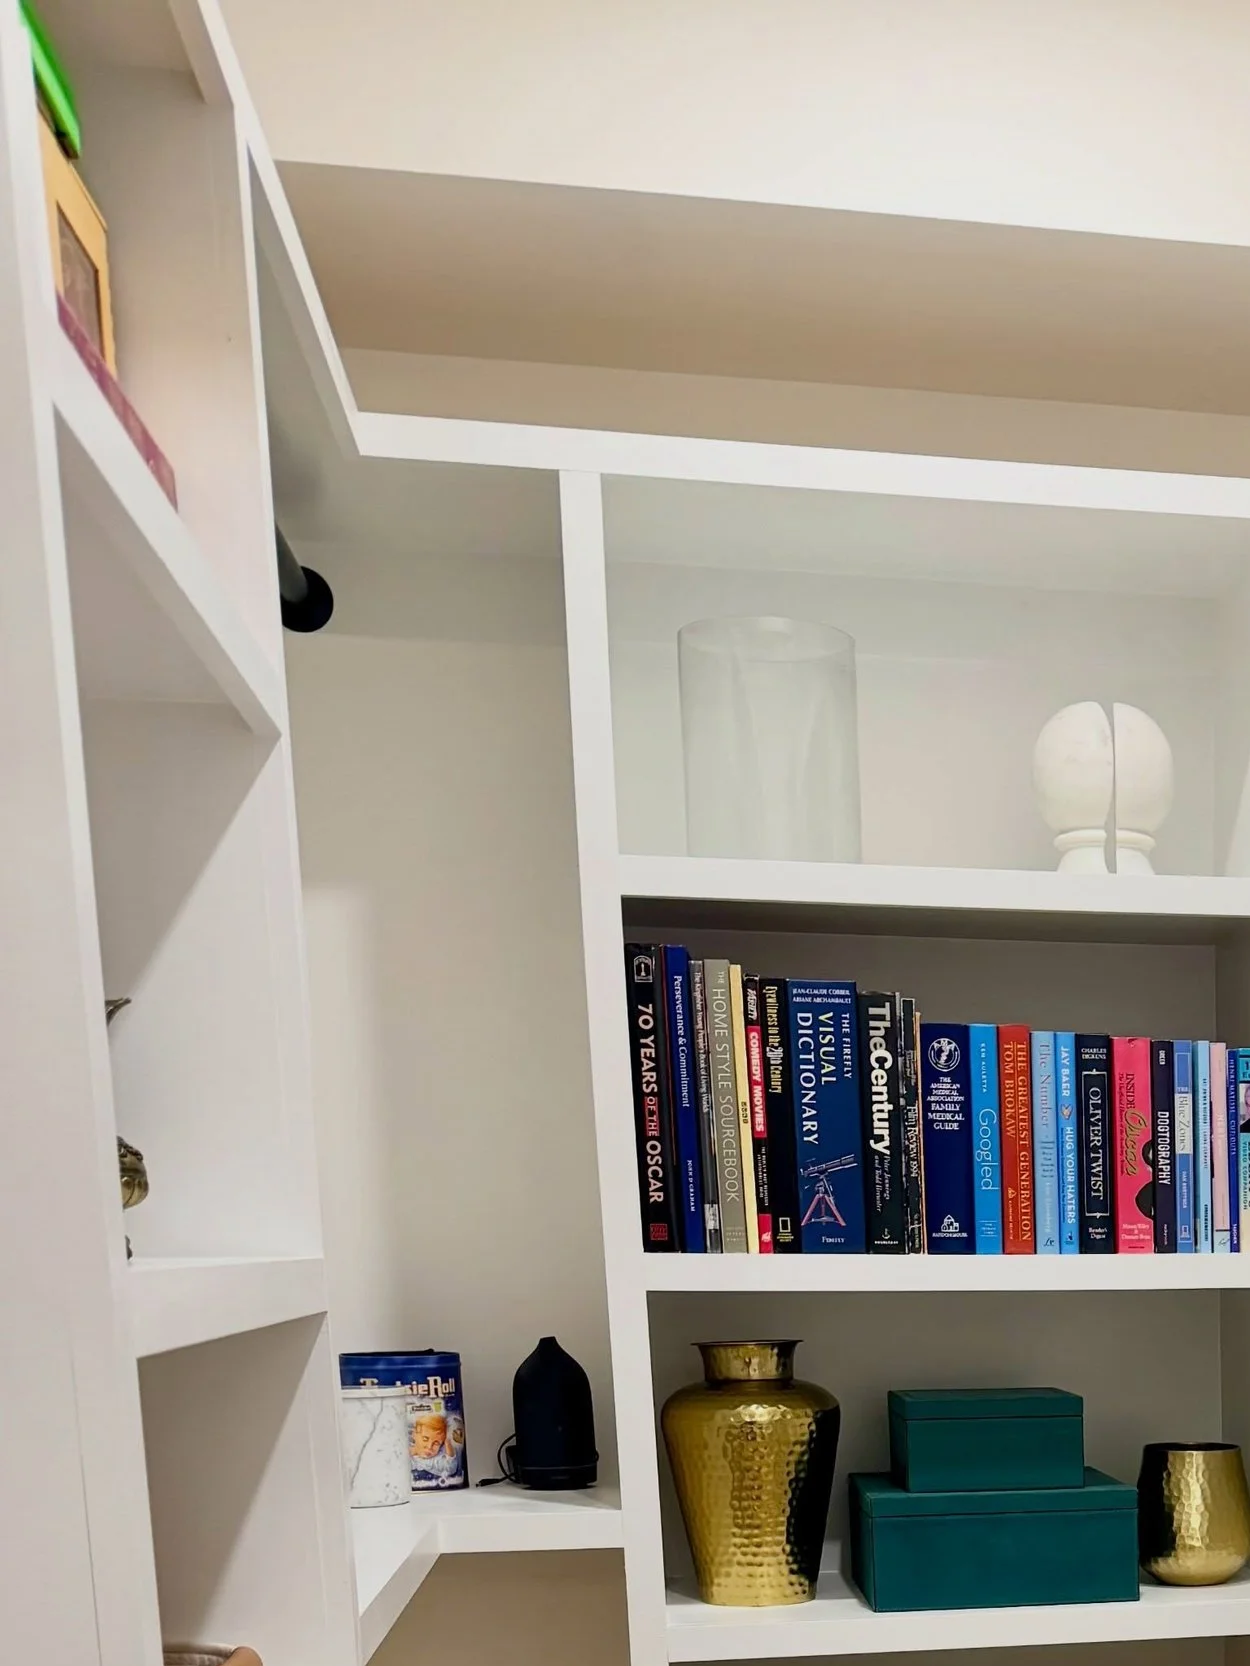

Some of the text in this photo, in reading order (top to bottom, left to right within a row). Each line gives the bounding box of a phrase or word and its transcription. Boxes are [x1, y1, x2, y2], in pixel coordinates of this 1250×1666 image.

[674, 975, 690, 1107] Perseverance & Commitment
[713, 989, 728, 1036] HOME
[818, 1012, 836, 1085] VISUAL
[841, 1013, 852, 1078] THE FIREFLY
[638, 1004, 664, 1203] 70 YEARS OF THE OSCAR
[716, 1044, 731, 1089] STYLE
[750, 1032, 764, 1132] COMEDY MOVIES
[797, 1013, 818, 1144] DICTIONARY
[1003, 1041, 1016, 1138] TOM BROKAW
[1040, 1042, 1053, 1127] The Number
[1061, 1046, 1070, 1097] JAY BAER
[1178, 1096, 1188, 1119] Blue
[720, 1096, 739, 1202] SOURCEBOOK
[928, 1112, 965, 1120] MEDICAL
[933, 1122, 960, 1130] GUIDE
[976, 1108, 999, 1190] Googled
[1017, 1041, 1032, 1240] THE GREATEST GENERATION
[1088, 1087, 1104, 1200] OLIVER TWIST
[1124, 1073, 1147, 1176] INSIDE Oscar
[1157, 1111, 1171, 1185] DOGTOGRAPHY
[1065, 1127, 1076, 1224] HUG YOUR HATERS
[427, 1376, 456, 1398] Roll
